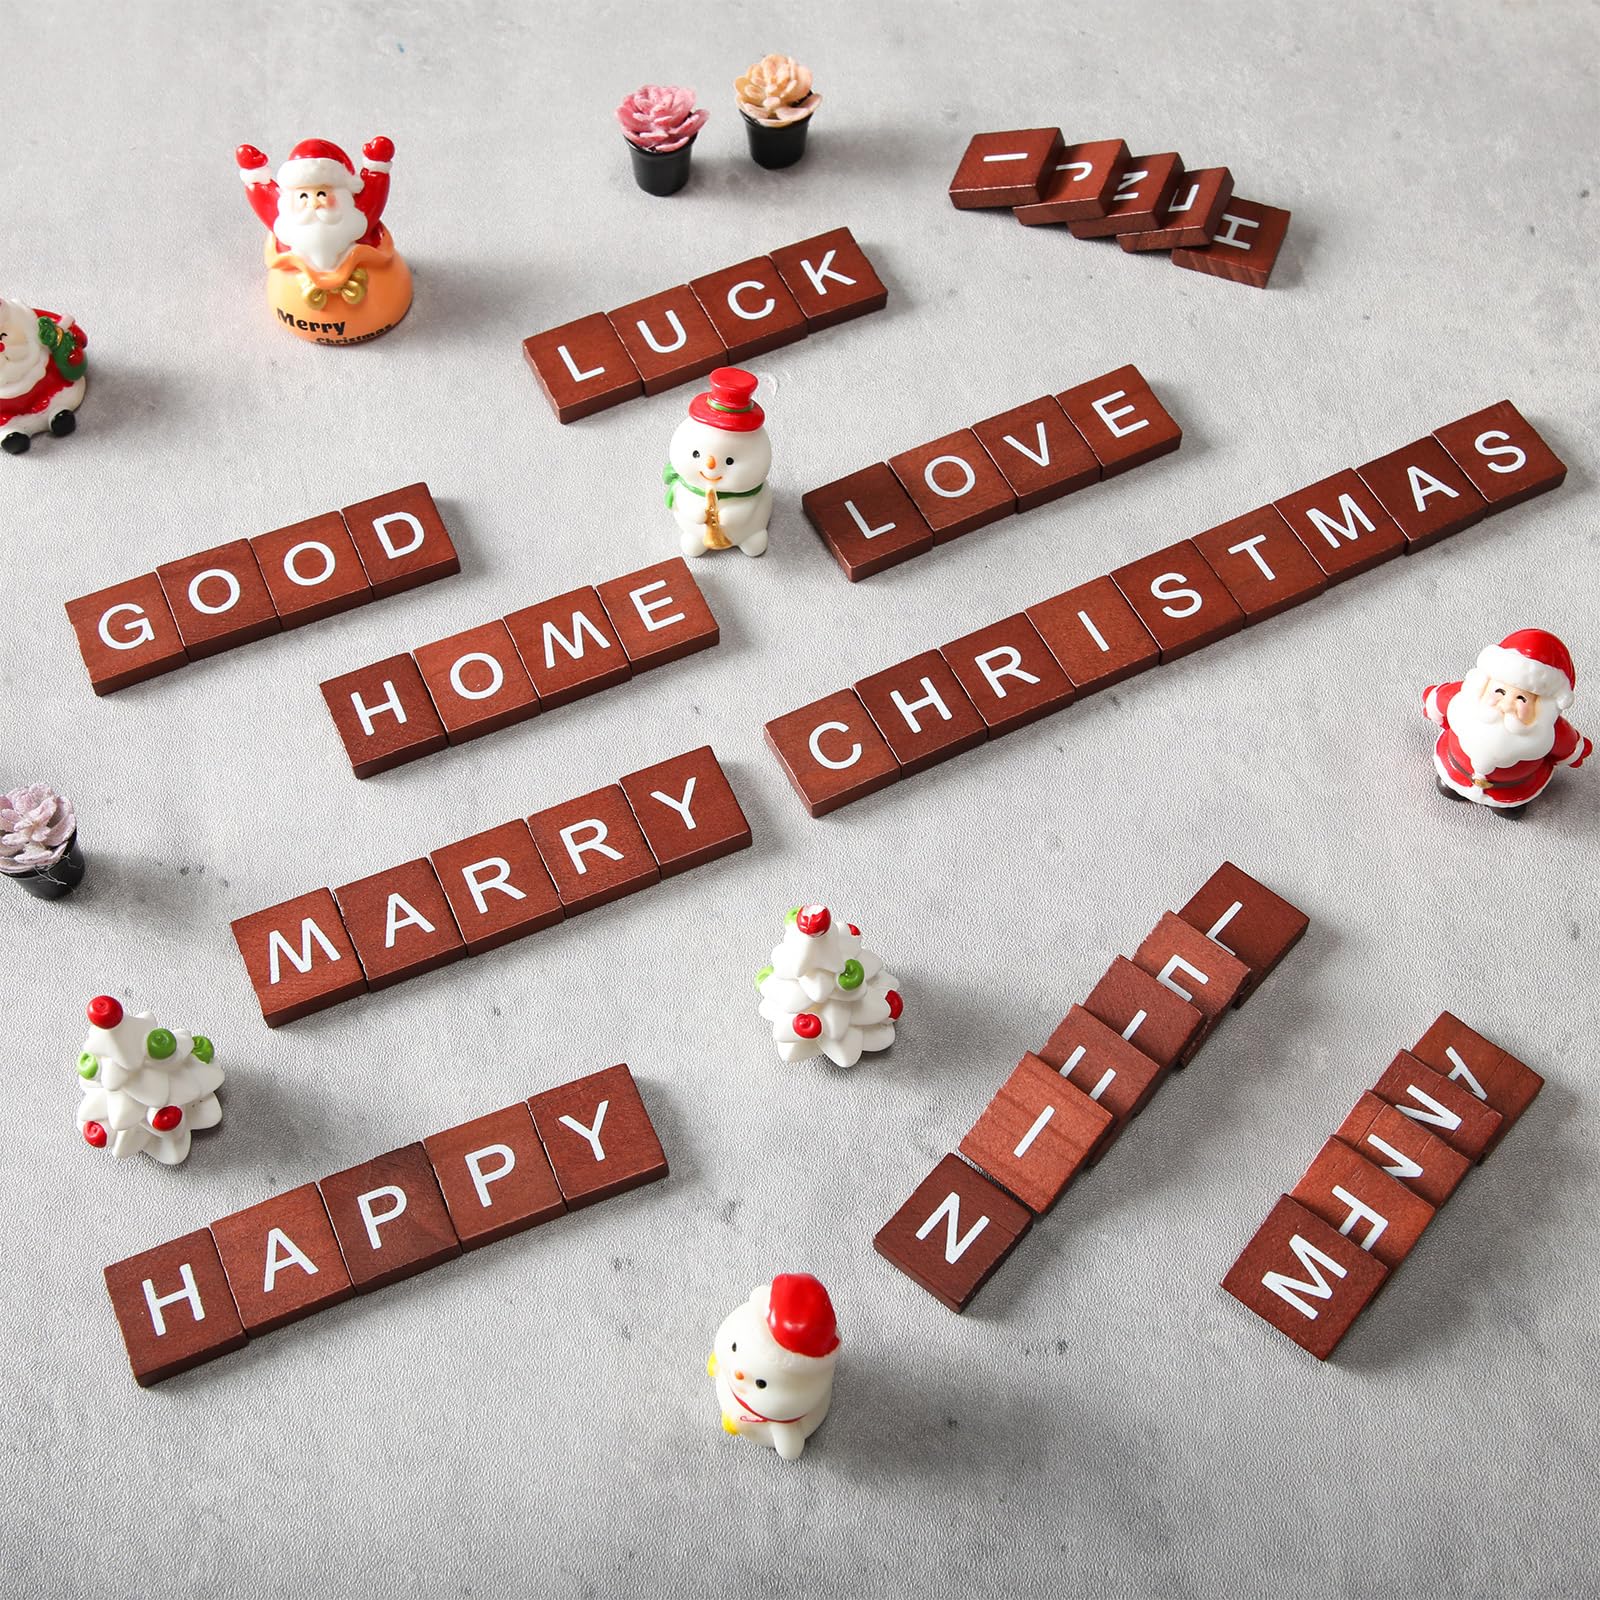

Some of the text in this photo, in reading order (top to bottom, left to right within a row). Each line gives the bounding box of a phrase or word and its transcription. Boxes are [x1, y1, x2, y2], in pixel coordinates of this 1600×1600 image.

[277, 308, 345, 336] Merry
[557, 249, 857, 383] LUCK
[844, 390, 1150, 539] LOVE
[98, 511, 425, 650] GOOD
[808, 430, 1526, 770] CHRISTMAS
[350, 579, 686, 736] HOME
[269, 776, 697, 985] MARRY
[141, 1100, 609, 1337] HAPPY
